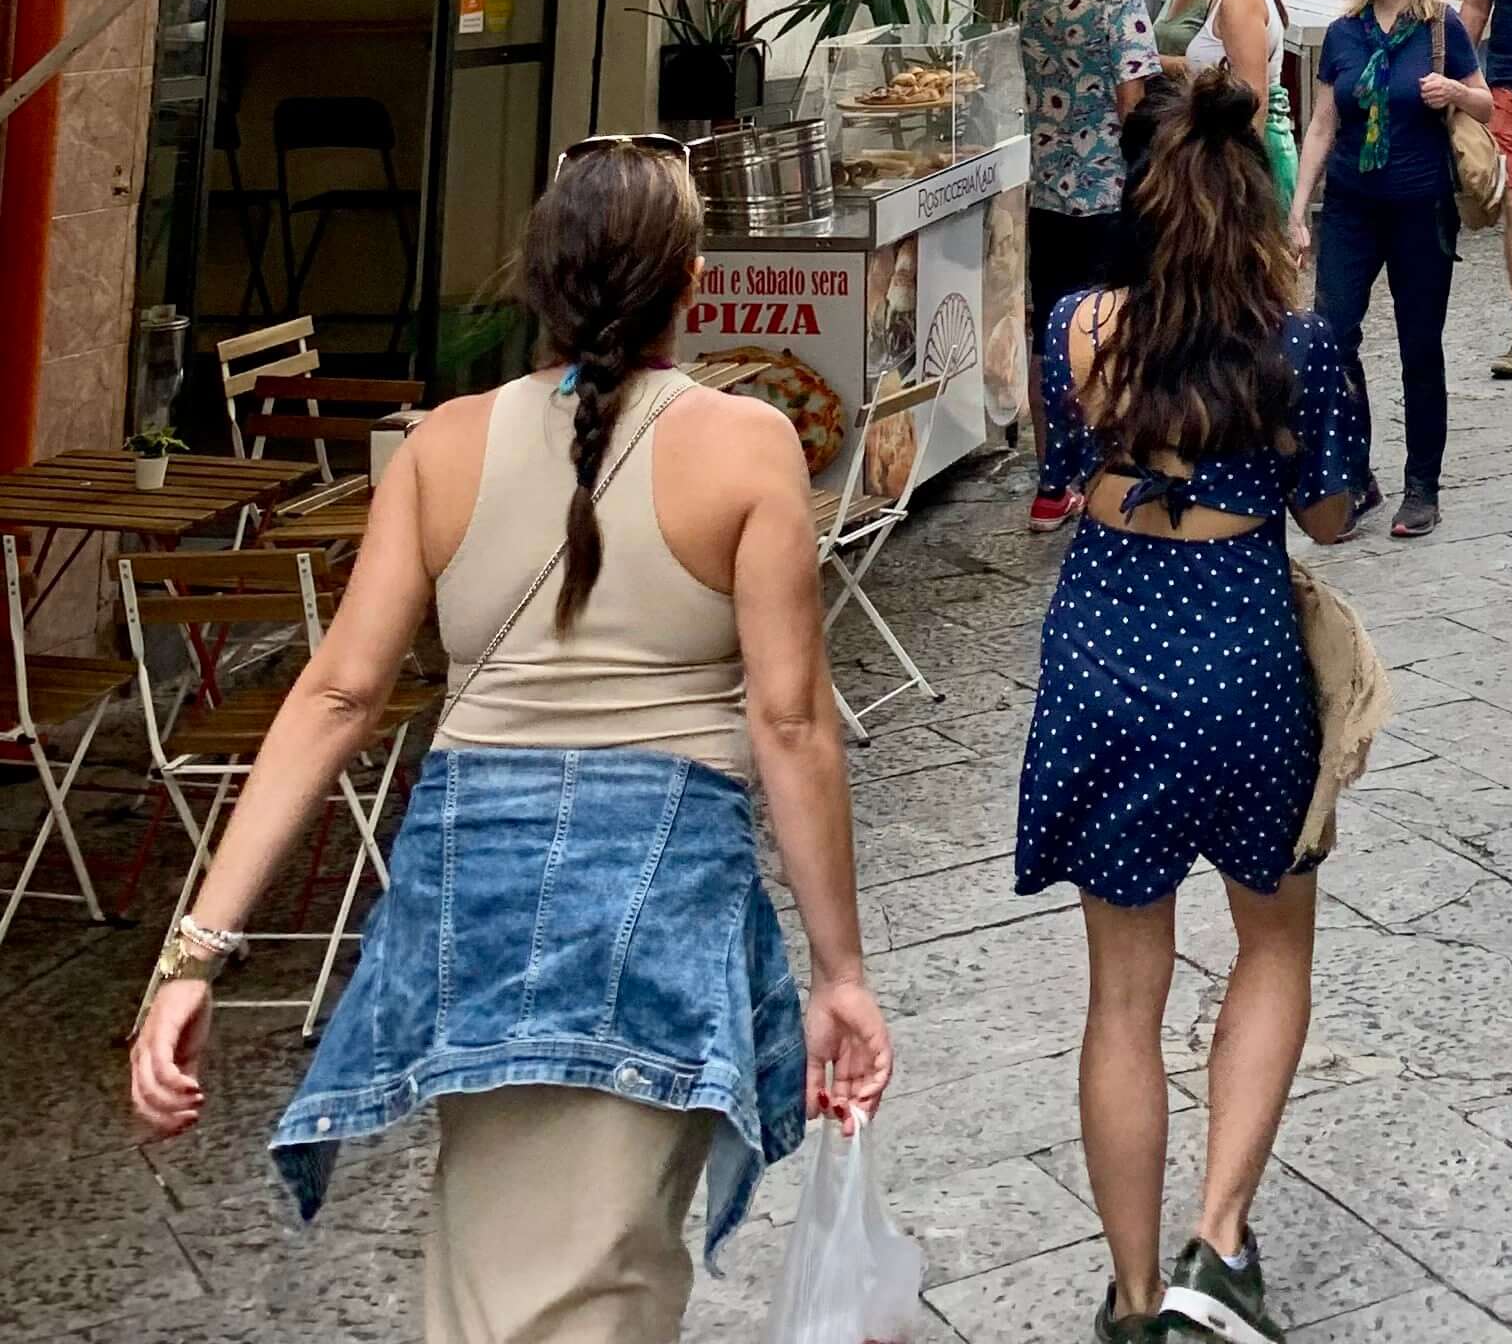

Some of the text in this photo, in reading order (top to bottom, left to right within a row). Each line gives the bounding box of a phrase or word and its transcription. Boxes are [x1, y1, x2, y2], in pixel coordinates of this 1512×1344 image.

[731, 272, 741, 295] e
[746, 265, 805, 296] Sabato
[811, 269, 849, 296] sera
[684, 302, 821, 335] PIZZA
